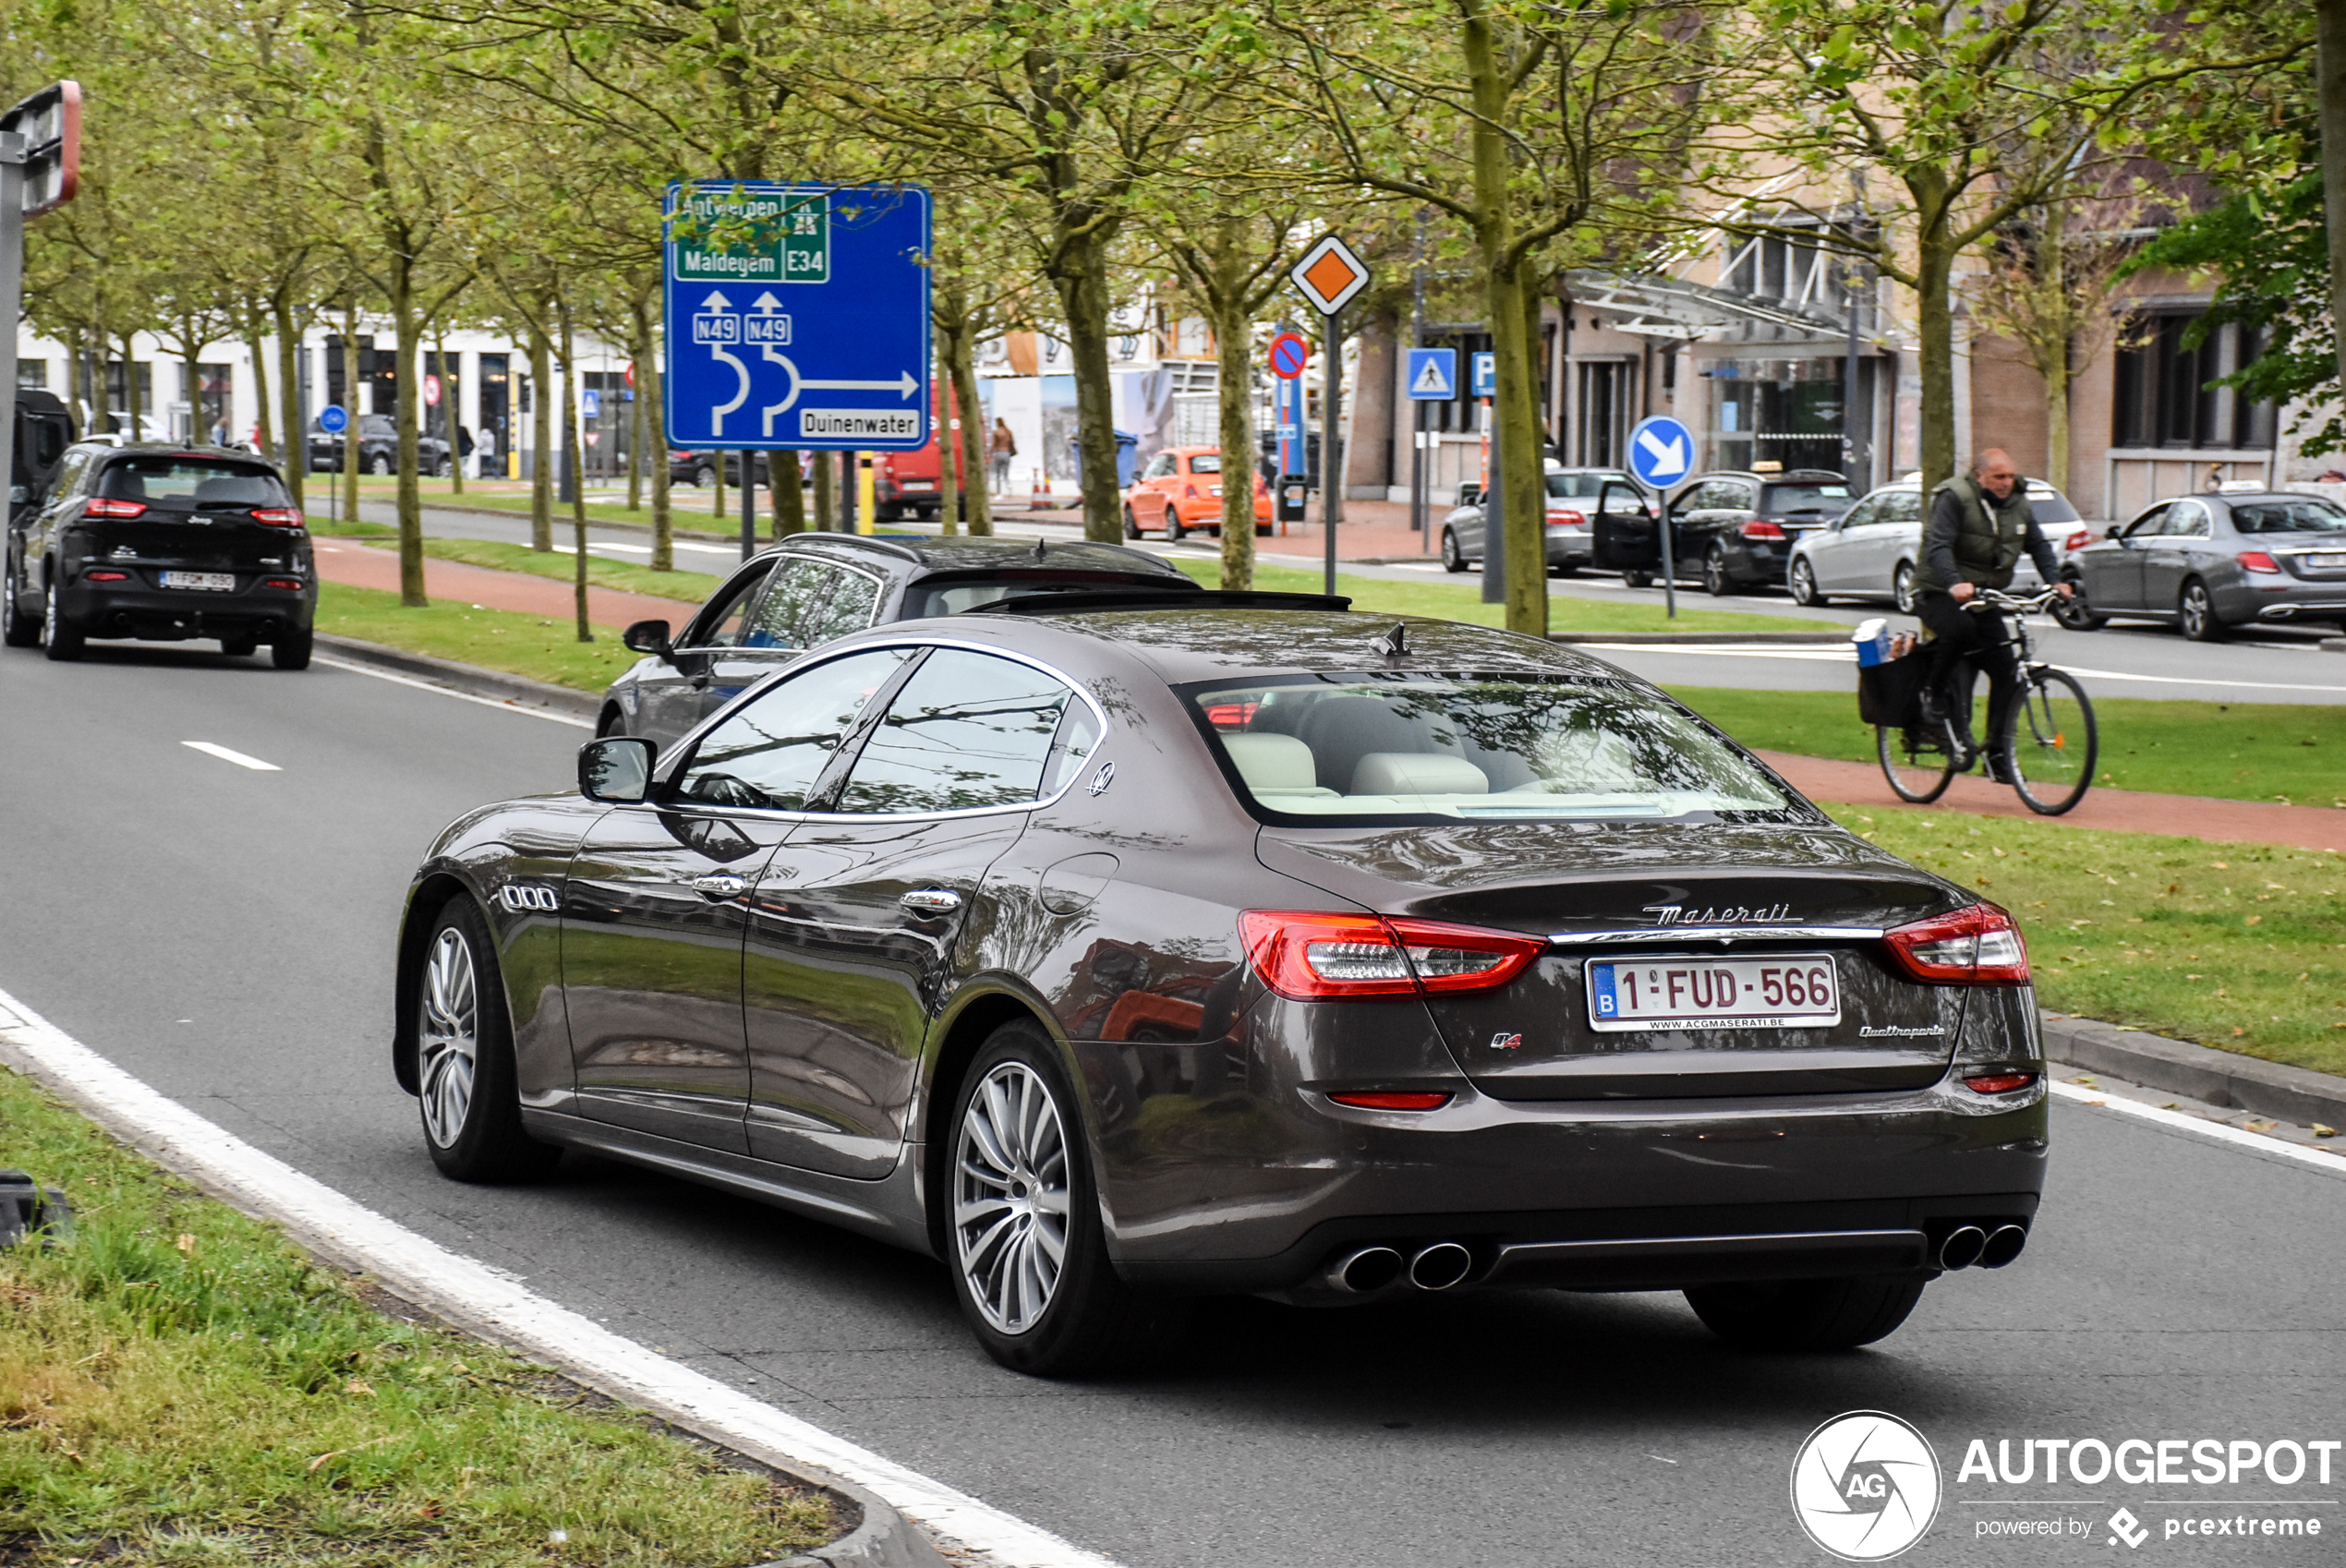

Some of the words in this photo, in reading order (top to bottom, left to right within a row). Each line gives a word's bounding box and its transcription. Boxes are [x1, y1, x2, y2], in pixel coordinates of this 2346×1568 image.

[684, 250, 775, 277] Maldegem
[787, 250, 823, 271] E34
[698, 320, 736, 340] N49
[749, 320, 787, 341] N49
[1476, 356, 1494, 386] P
[805, 414, 914, 433] Duinenwater
[1642, 904, 1804, 925] Maserati
[1600, 995, 1614, 1013] B
[1650, 1019, 1785, 1030] WWW.ACGMASERATI.BE
